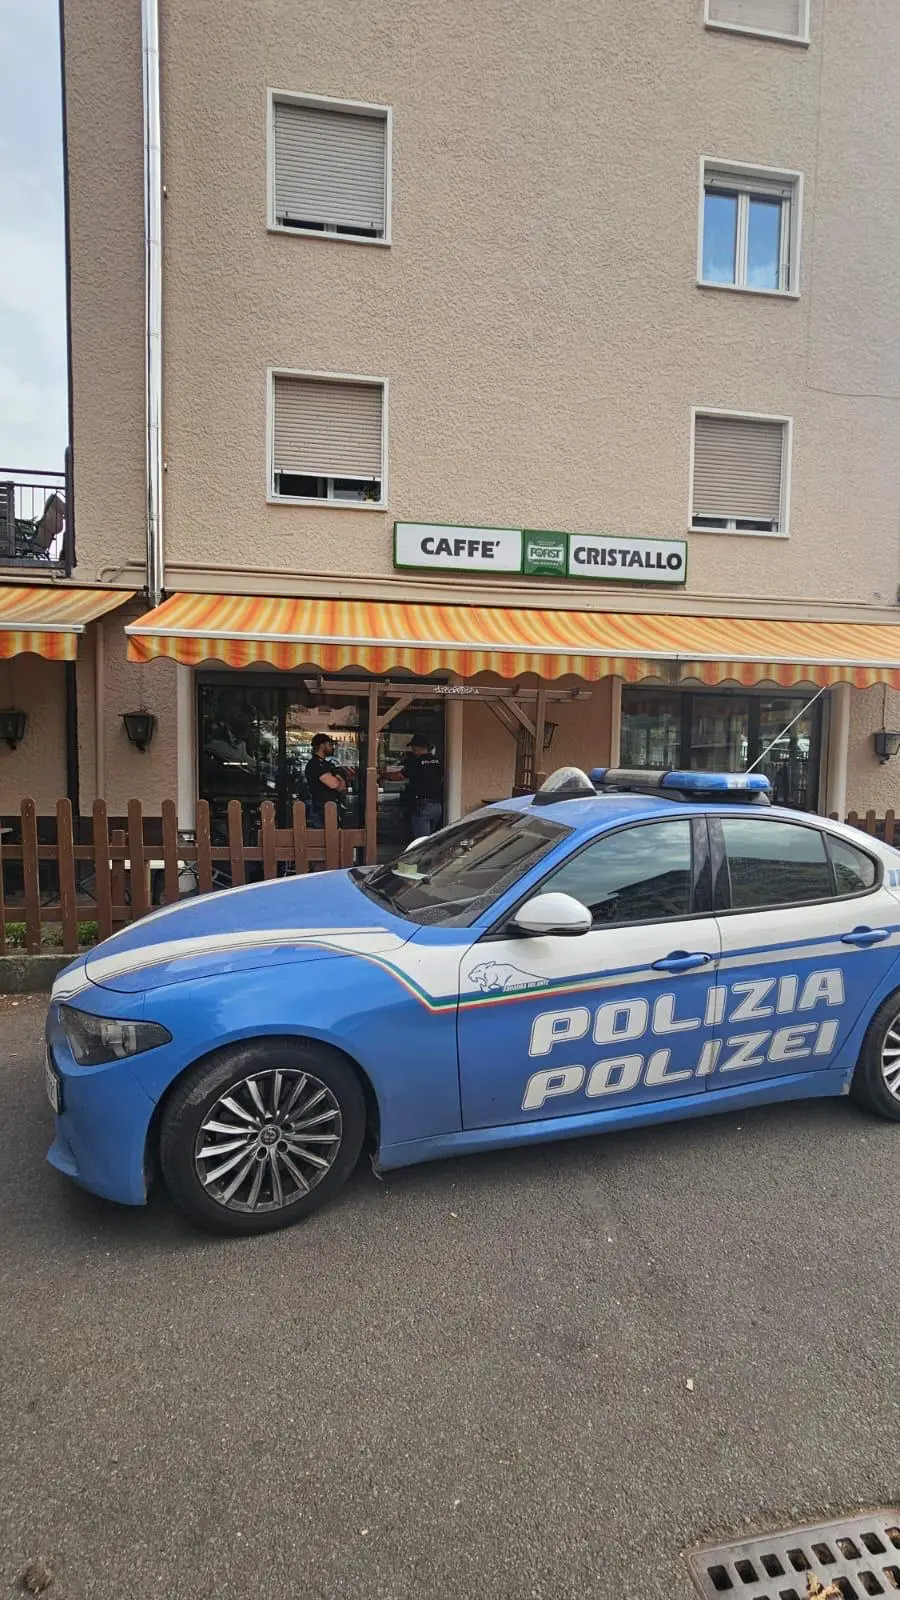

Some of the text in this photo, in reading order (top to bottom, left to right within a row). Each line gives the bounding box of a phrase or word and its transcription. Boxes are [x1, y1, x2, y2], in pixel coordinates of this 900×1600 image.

[530, 547, 562, 558] FORST
[573, 546, 683, 570] CRISTALLO
[529, 968, 846, 1057] POLIZIA
[521, 1019, 840, 1111] POLIZEI
